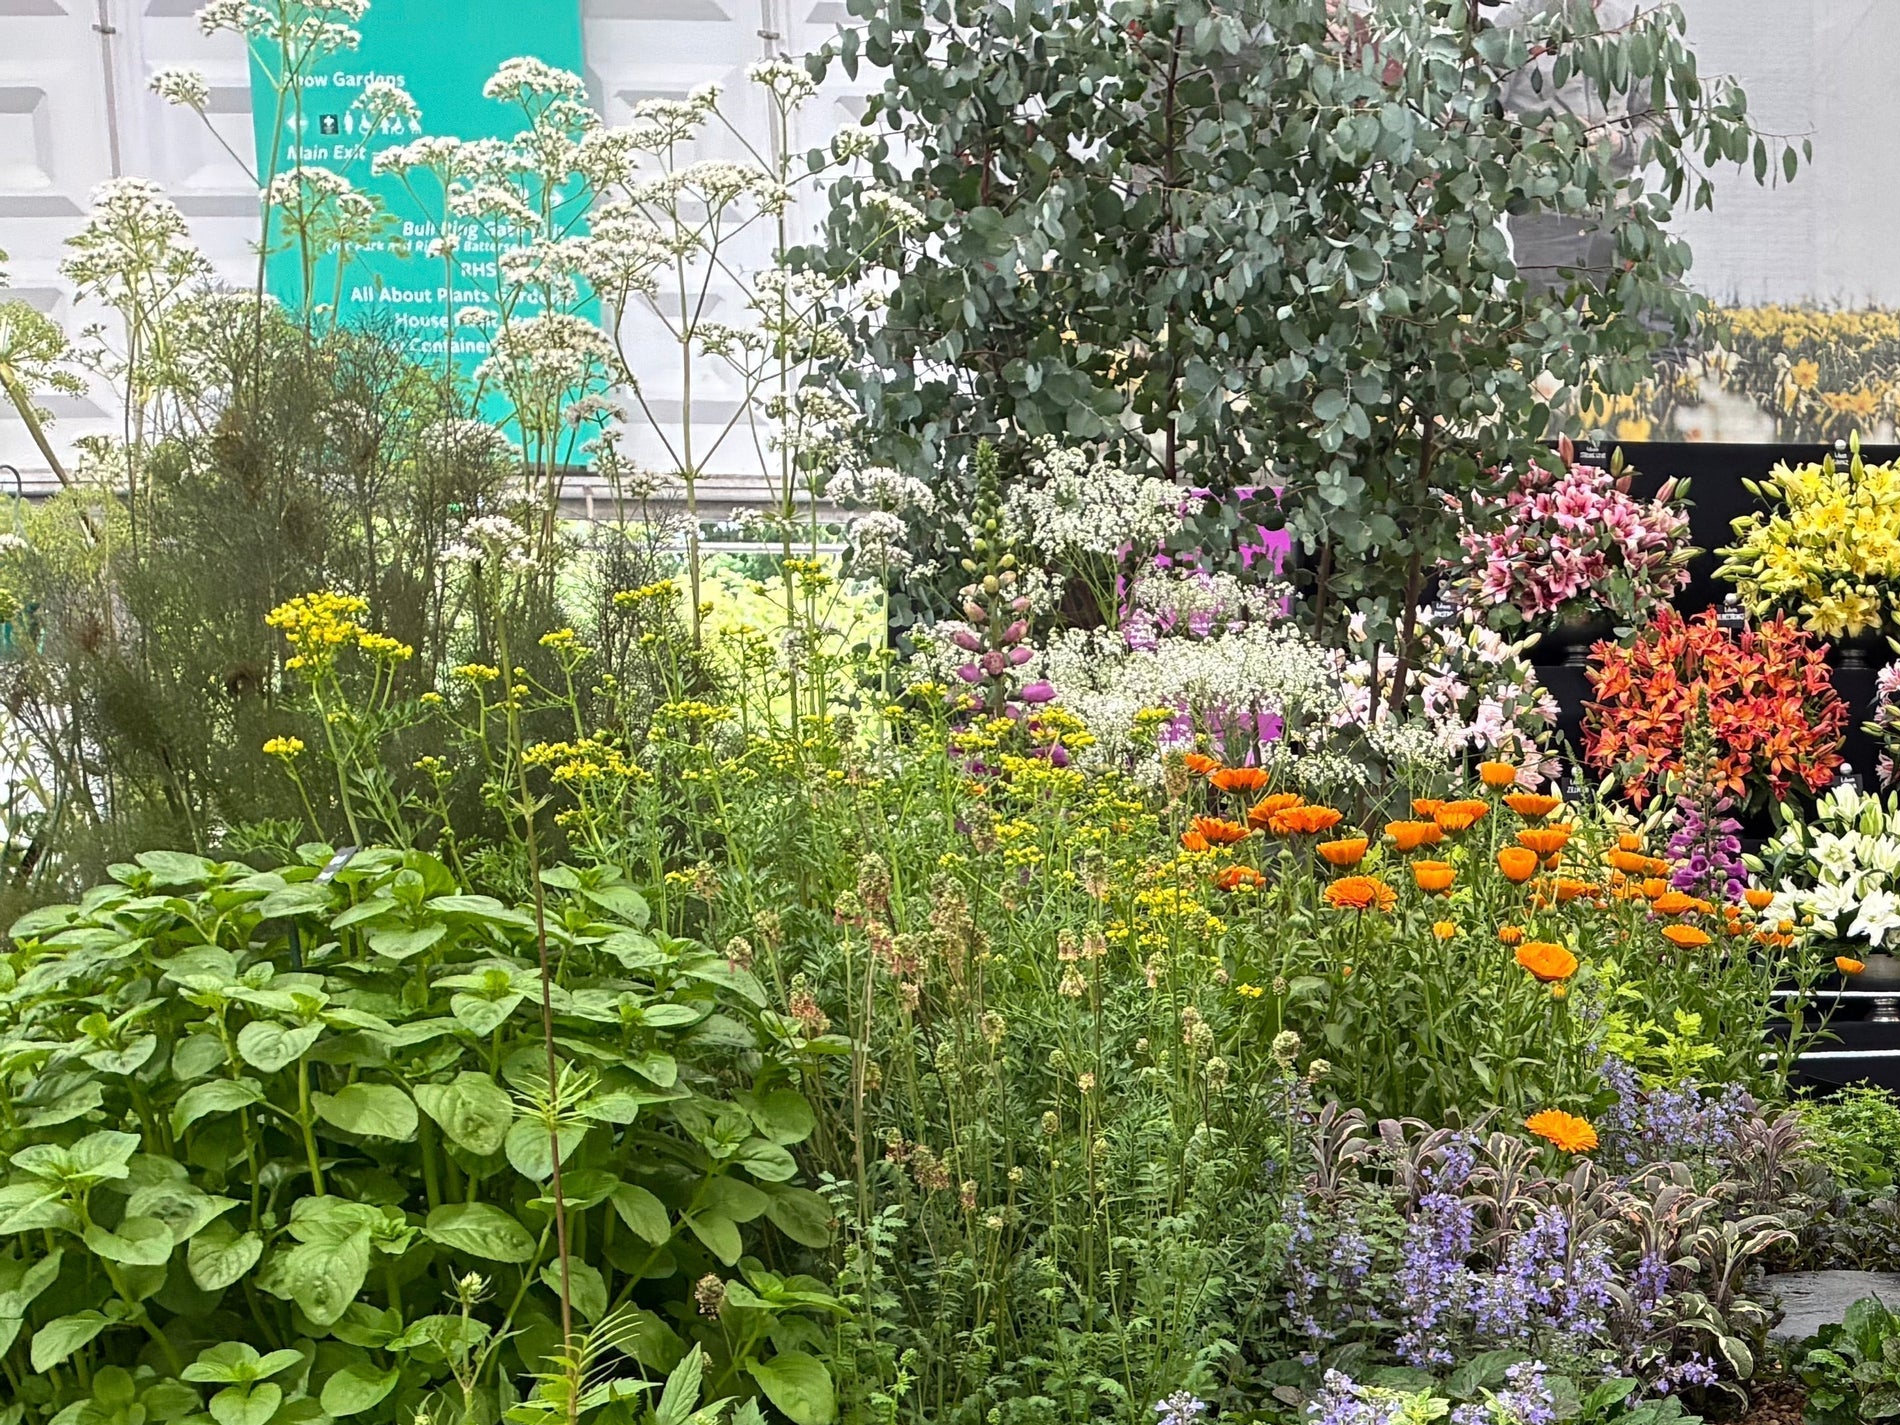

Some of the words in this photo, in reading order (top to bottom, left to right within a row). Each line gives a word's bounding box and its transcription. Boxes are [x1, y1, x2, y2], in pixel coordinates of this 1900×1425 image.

[334, 145, 366, 161] Exit
[461, 262, 497, 278] RHS
[351, 287, 373, 303] All
[379, 287, 433, 303] About
